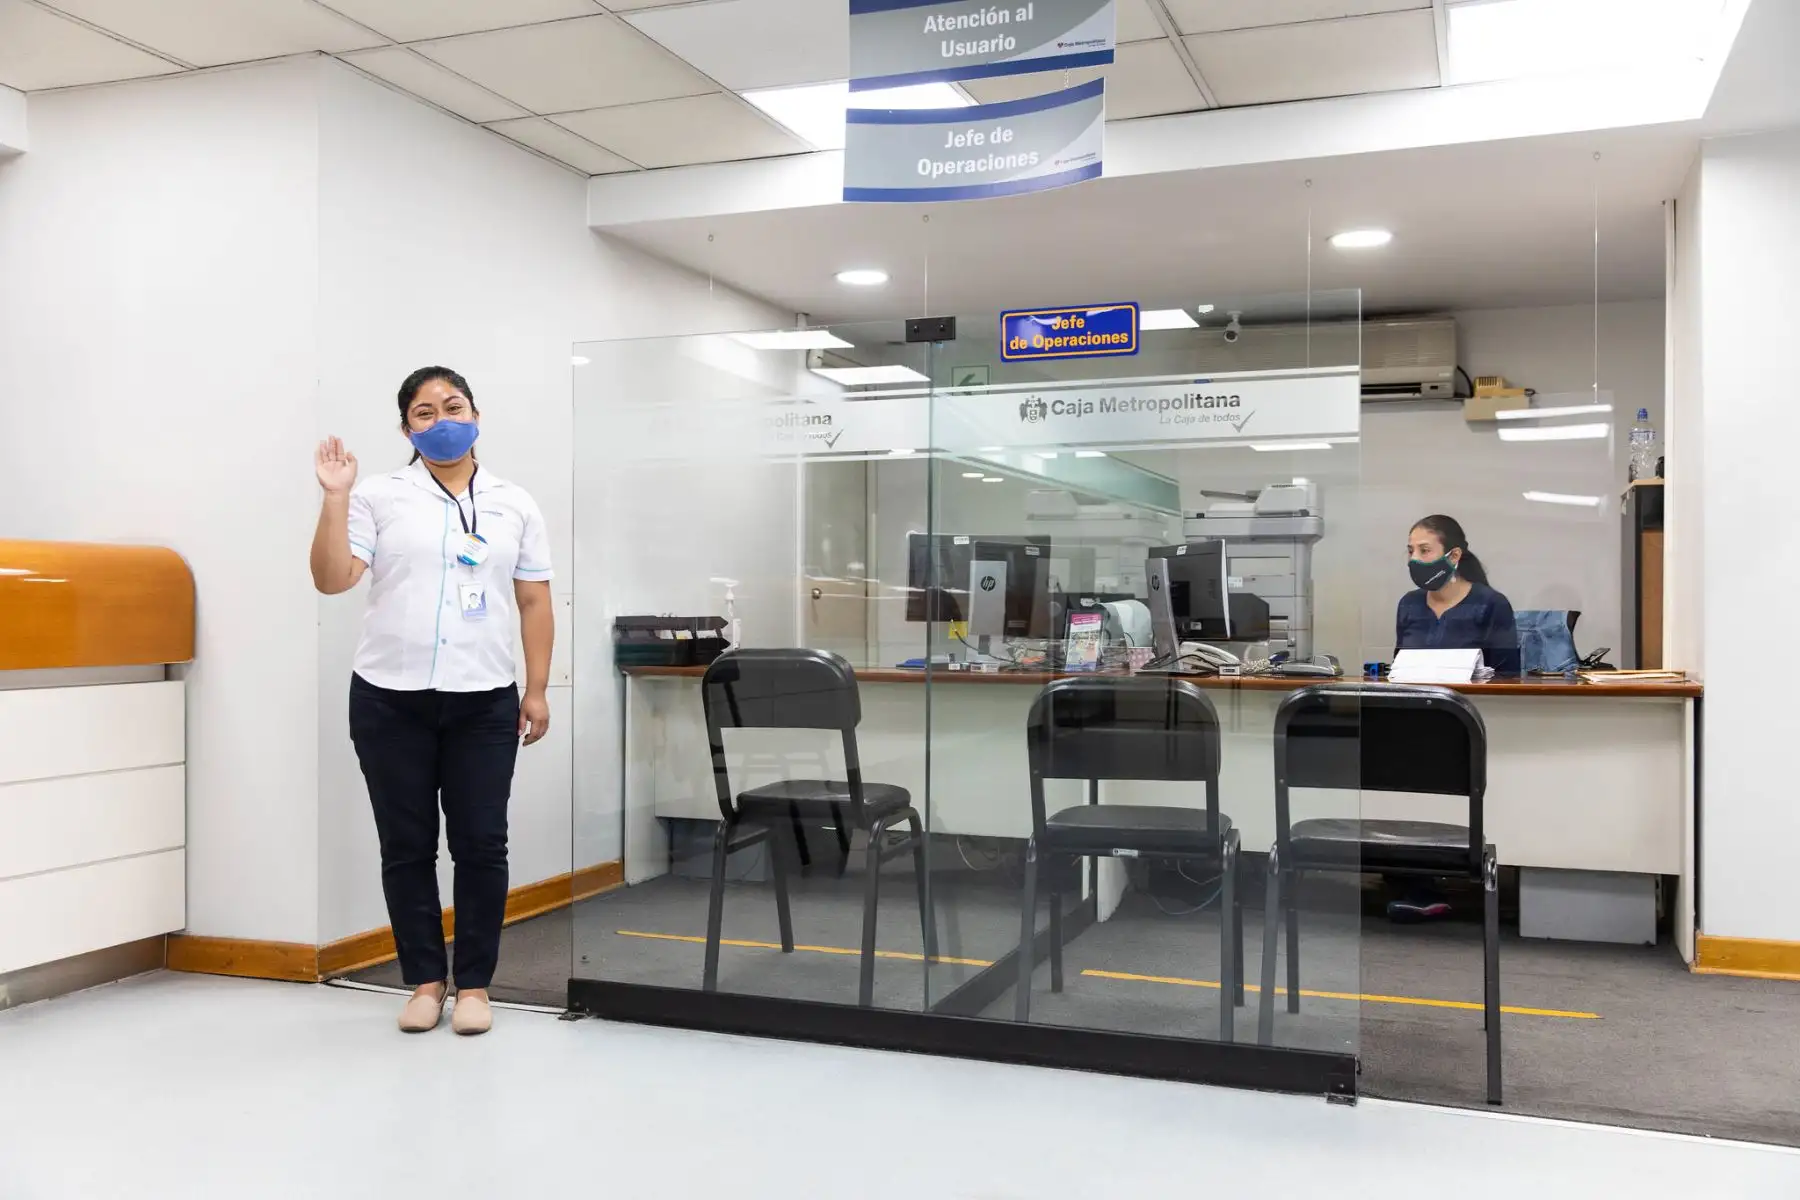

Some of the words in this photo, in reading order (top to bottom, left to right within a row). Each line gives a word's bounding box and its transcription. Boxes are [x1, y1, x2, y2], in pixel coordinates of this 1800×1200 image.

[923, 6, 1010, 34] Atención
[1015, 2, 1034, 22] al
[941, 33, 1016, 58] Usuario
[944, 129, 985, 149] Jefe
[990, 126, 1014, 144] de
[917, 151, 1039, 179] Operaciones
[1051, 315, 1085, 330] Jefe
[1009, 336, 1028, 350] de
[1032, 331, 1129, 351] Operaciones
[1051, 398, 1094, 418] Caja
[1099, 393, 1241, 414] Metropolitana
[1174, 413, 1197, 425] Caja
[1198, 414, 1211, 423] de
[1213, 412, 1241, 423] todos
